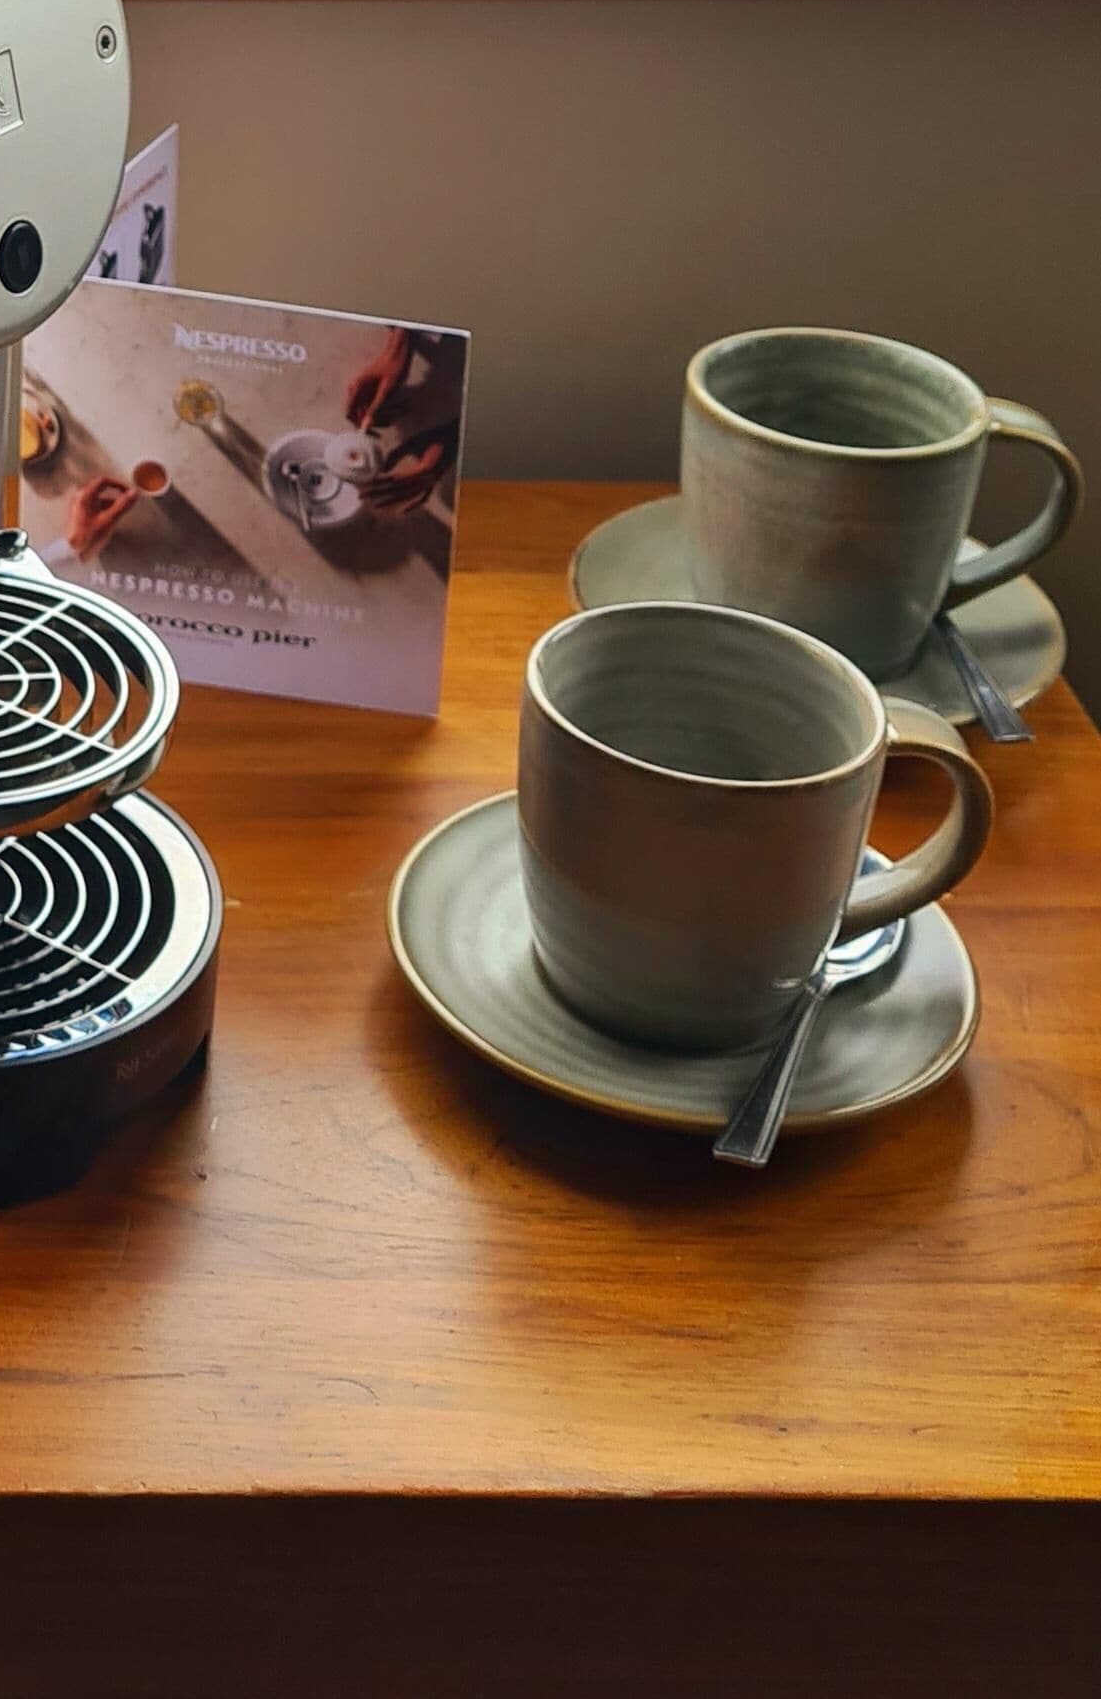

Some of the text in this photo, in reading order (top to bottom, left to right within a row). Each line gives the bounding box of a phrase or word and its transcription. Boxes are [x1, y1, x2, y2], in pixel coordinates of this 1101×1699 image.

[171, 322, 308, 364] NESPRESSO
[90, 570, 235, 605] NESPRESSO
[252, 628, 317, 649] pier
